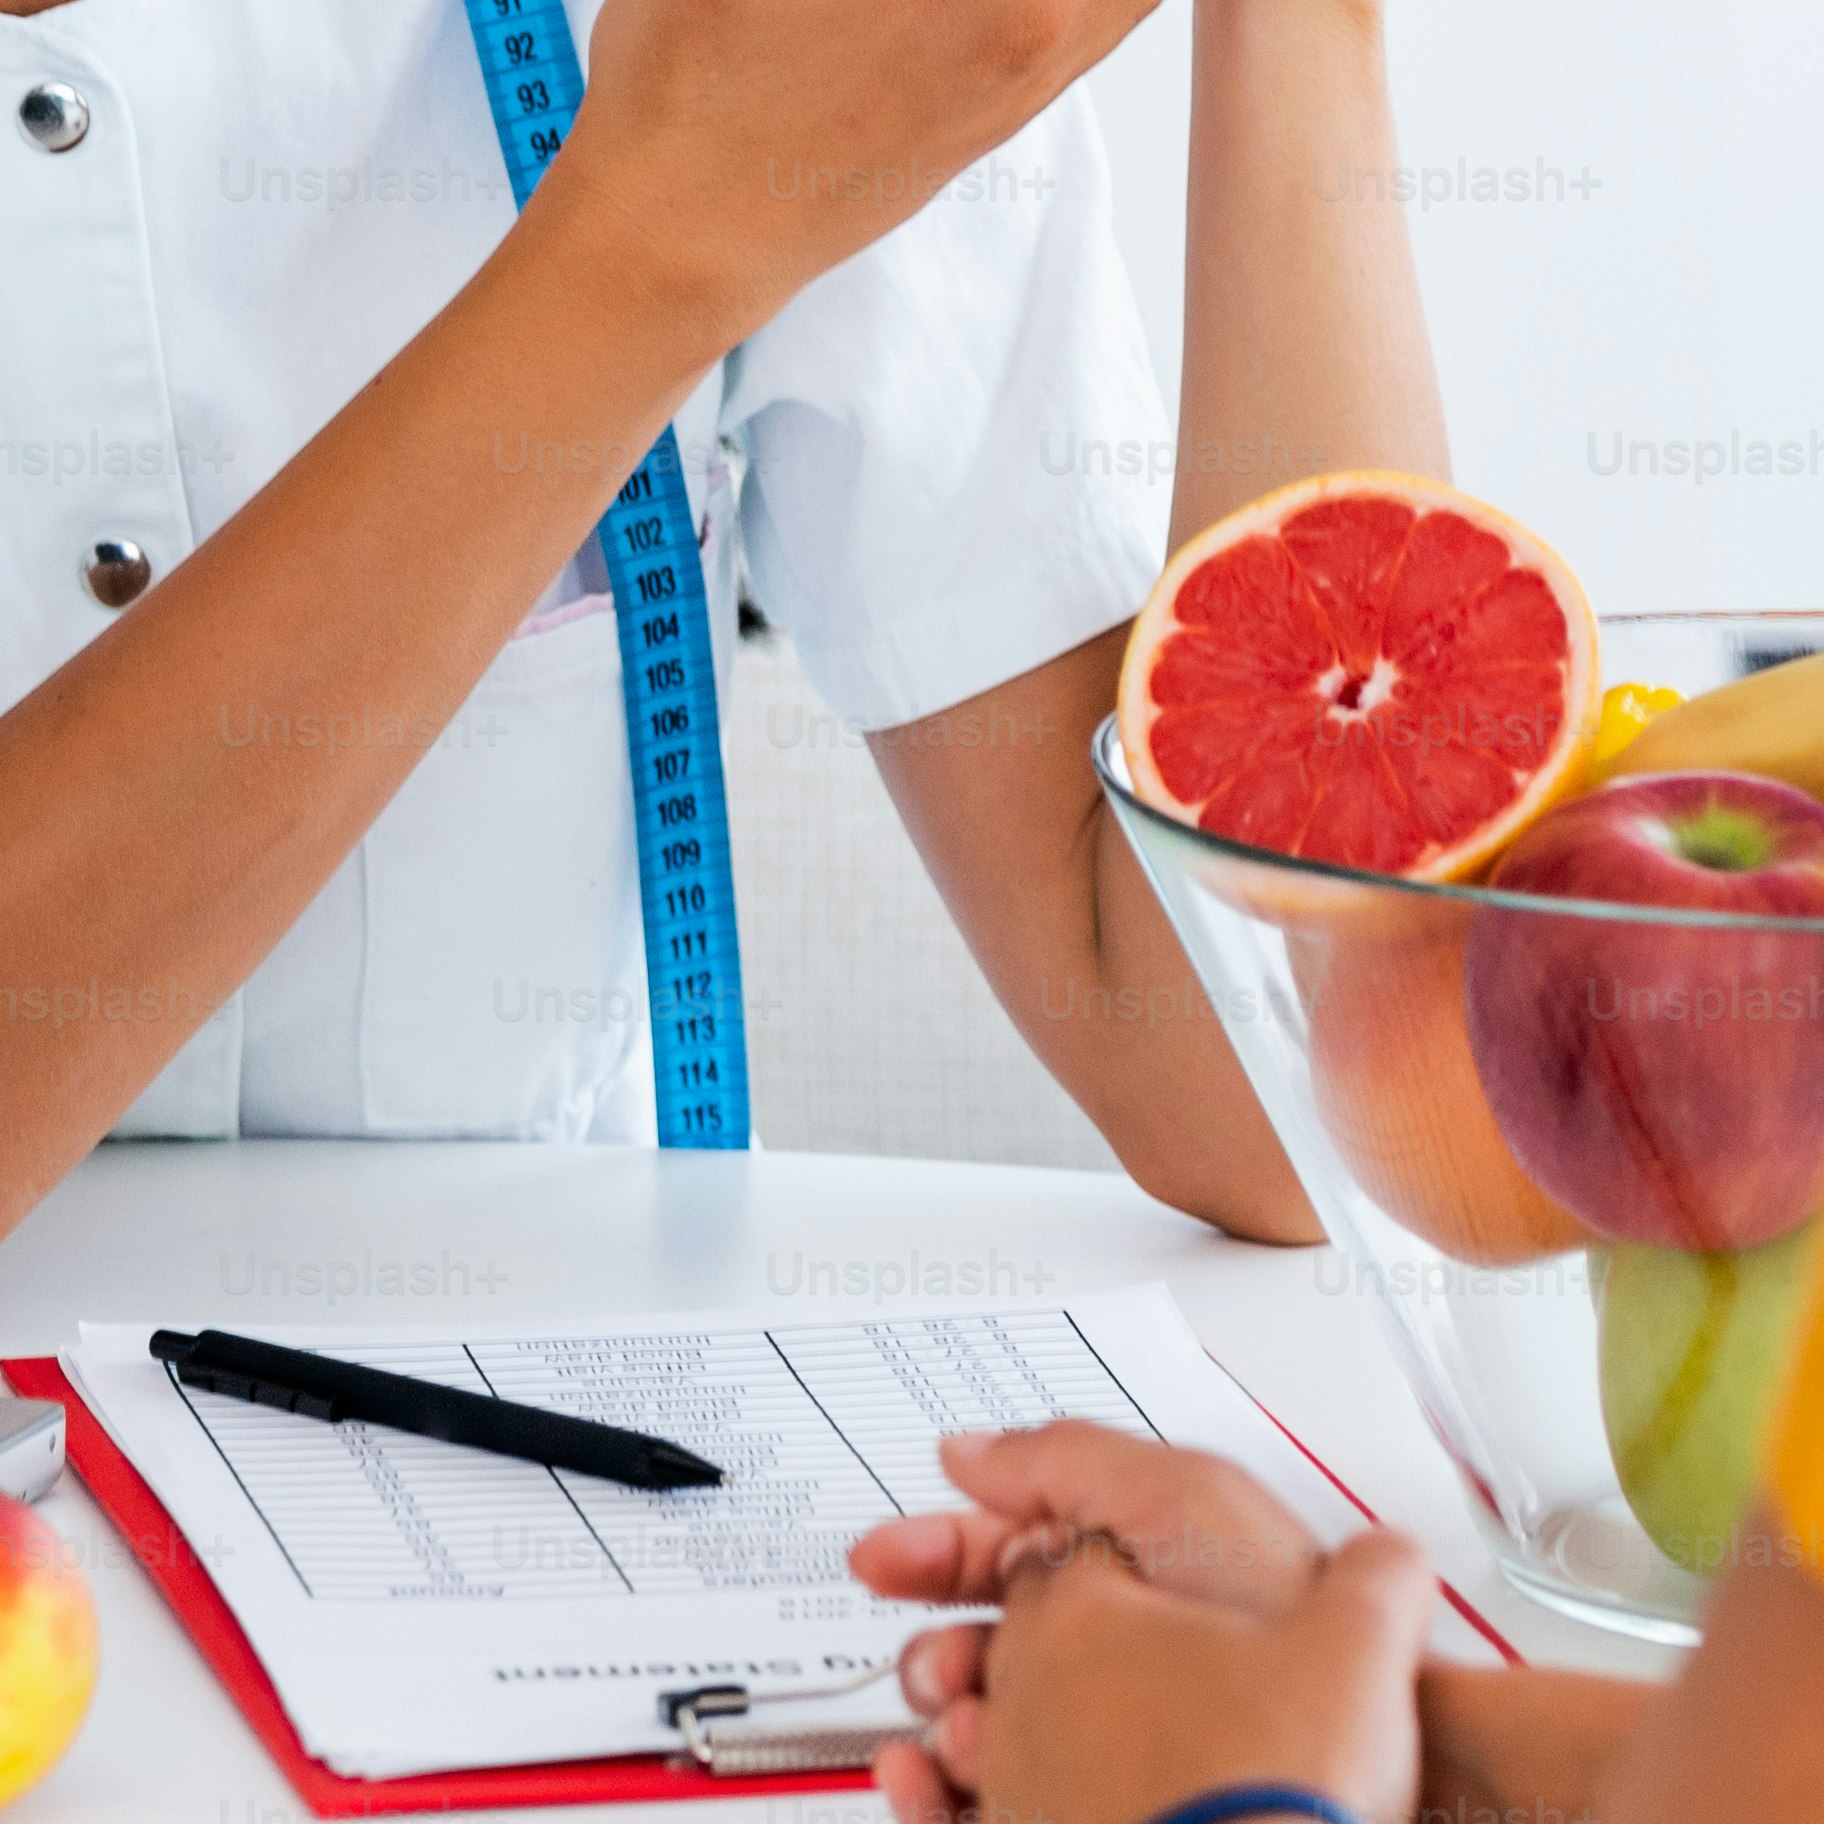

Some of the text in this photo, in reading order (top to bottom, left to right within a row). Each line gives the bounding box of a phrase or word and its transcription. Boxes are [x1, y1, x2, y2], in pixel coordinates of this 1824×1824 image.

[504, 31, 537, 64] 92
[516, 78, 550, 112] 93
[530, 125, 561, 159] 94
[625, 517, 665, 552] 102
[636, 565, 676, 603] 103
[642, 612, 680, 647] 104
[646, 659, 685, 693] 105
[651, 705, 689, 738] 106
[653, 748, 691, 783] 107
[658, 794, 696, 827] 108
[661, 839, 701, 872] 109
[665, 884, 705, 916] 110
[671, 929, 707, 960] 111
[673, 972, 712, 1001] 112
[676, 1015, 716, 1045] 113
[679, 1058, 719, 1087] 114
[681, 1104, 722, 1133] 115
[493, 1658, 804, 1682] Statement
